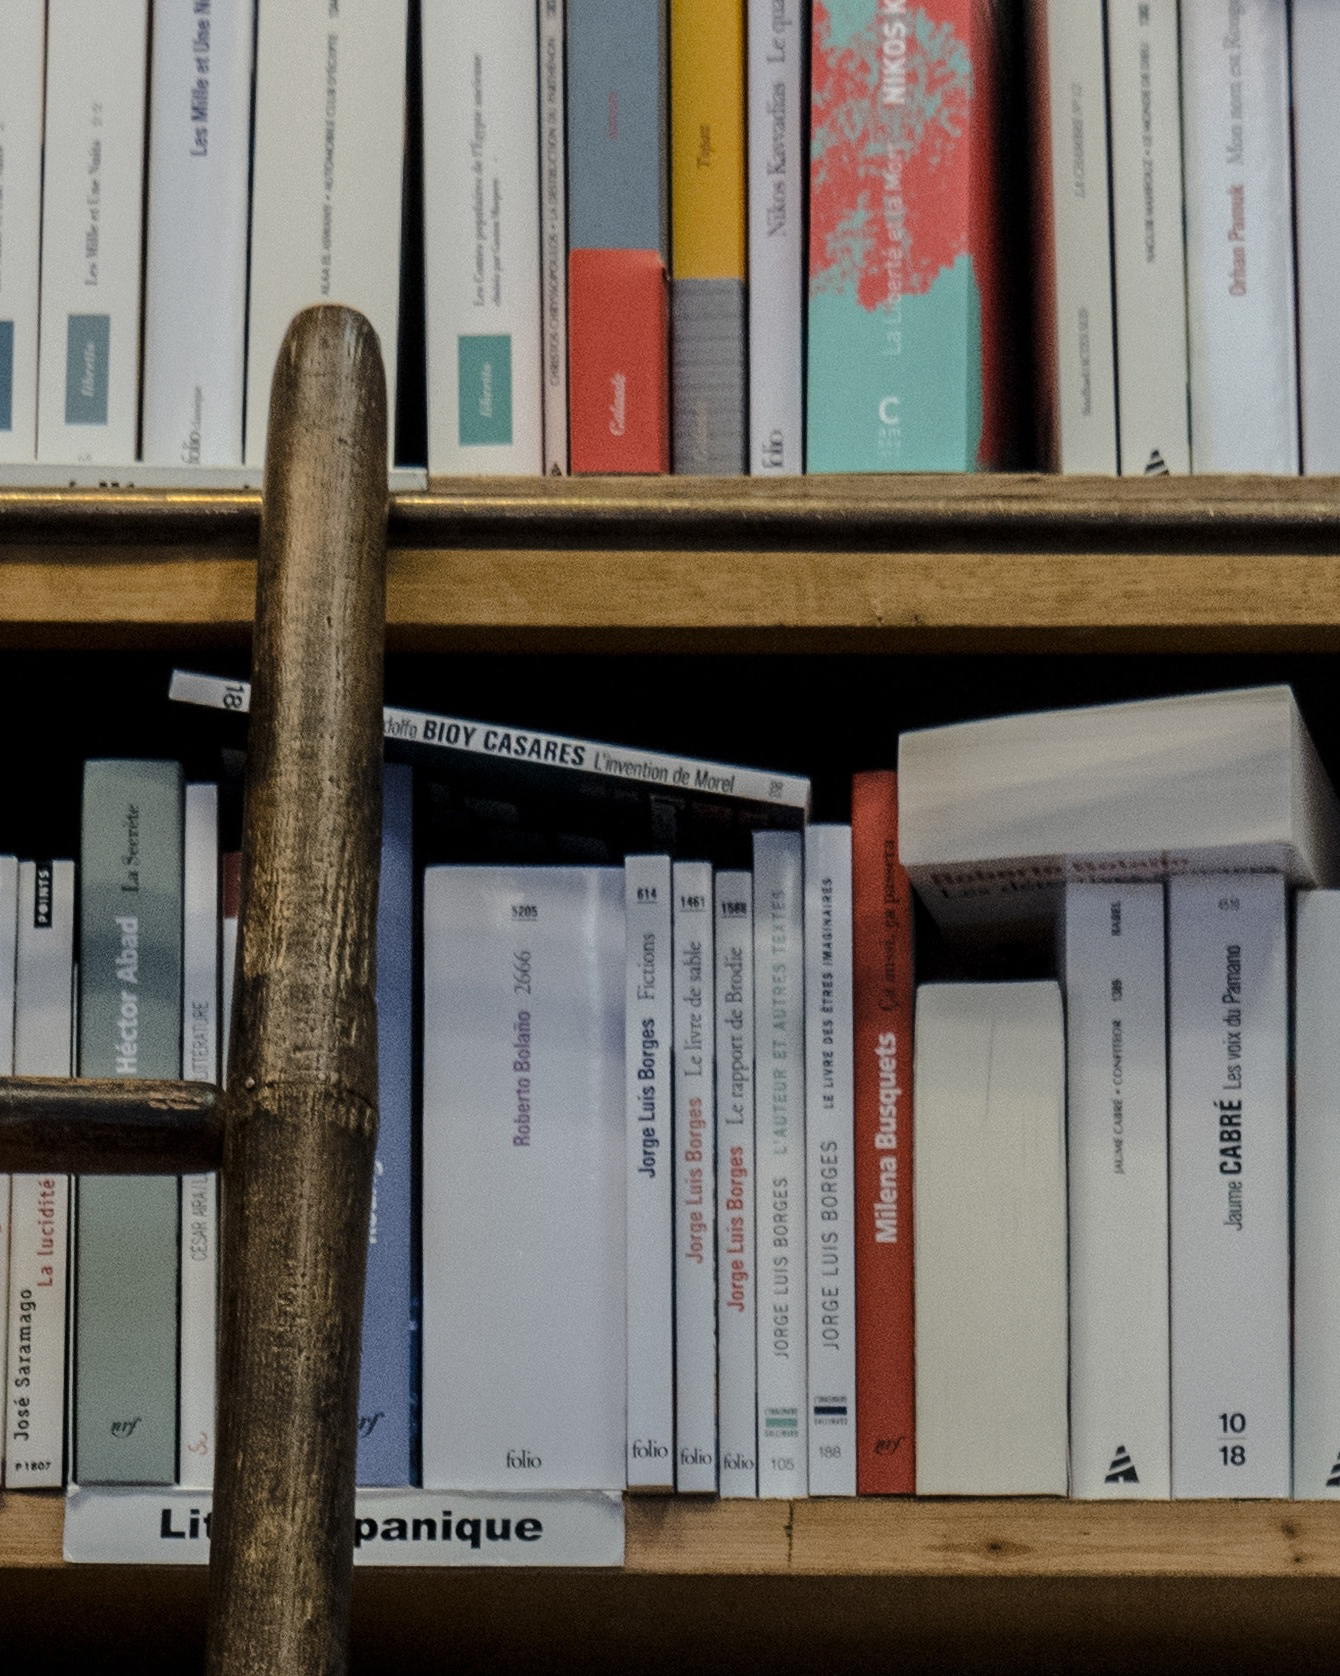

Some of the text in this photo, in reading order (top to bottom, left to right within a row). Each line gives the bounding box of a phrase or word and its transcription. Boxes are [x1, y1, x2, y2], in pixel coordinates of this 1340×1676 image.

[421, 719, 475, 748] BIOY
[483, 728, 585, 768] CASARES
[671, 764, 690, 786] de
[693, 767, 736, 794] Morel
[114, 915, 139, 1074] Héctor Abad
[512, 950, 531, 1146] Roberto Bolaño 2666
[637, 930, 660, 1178] Jorge Luis Borges Fictions
[874, 1032, 902, 1243] Milena Busquets
[1214, 944, 1243, 1231] Jaume CABRÉ Les voix du Pamano
[37, 1179, 55, 1287] La lucidité
[13, 1289, 36, 1440] José Saramago
[1220, 1413, 1246, 1433] 10
[506, 1449, 542, 1468] folio
[1220, 1445, 1246, 1466] 18
[354, 1509, 543, 1550] panique
